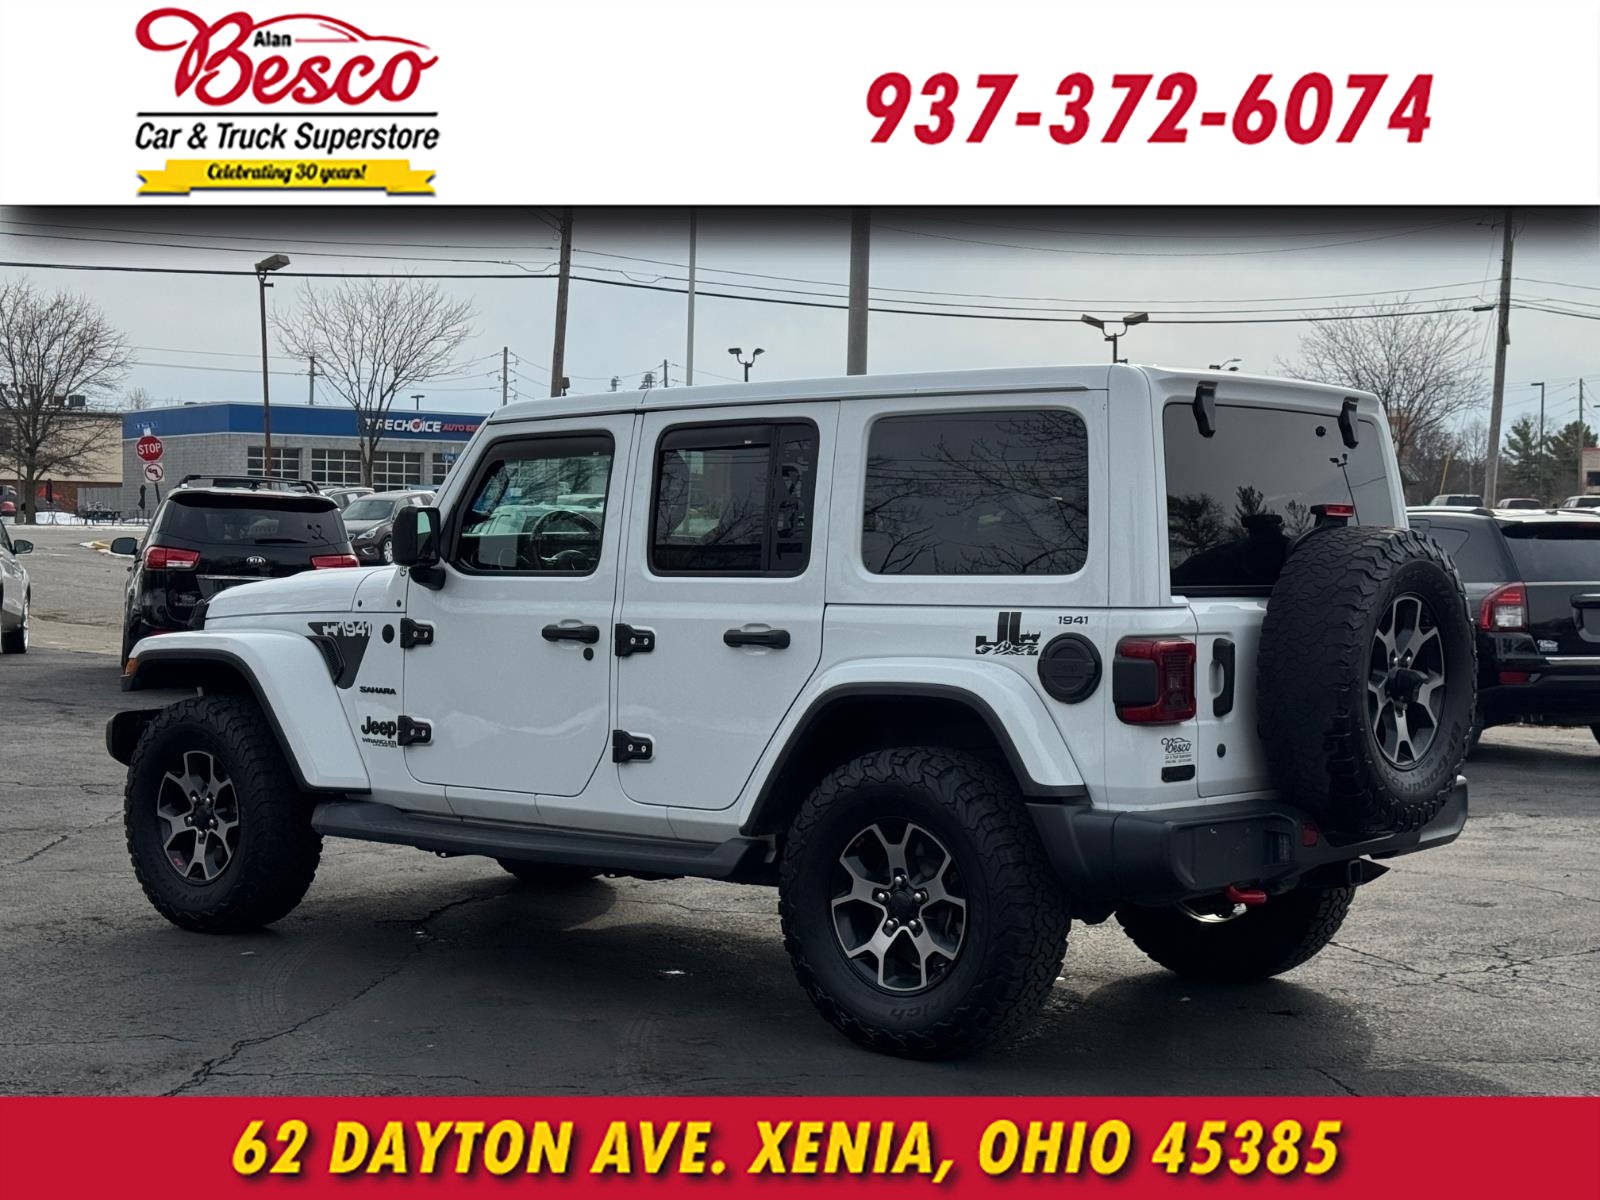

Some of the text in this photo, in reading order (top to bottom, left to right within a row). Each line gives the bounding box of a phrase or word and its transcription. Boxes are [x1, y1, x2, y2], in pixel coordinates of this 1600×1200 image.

[365, 418, 441, 432] TRECHOICE
[442, 424, 465, 432] AUTO
[138, 443, 160, 455] STOP
[1058, 616, 1089, 625] 1941
[338, 621, 372, 637] 1941
[359, 686, 397, 695] SAHARA
[360, 716, 397, 739] Jeep
[1161, 737, 1192, 753] Besco
